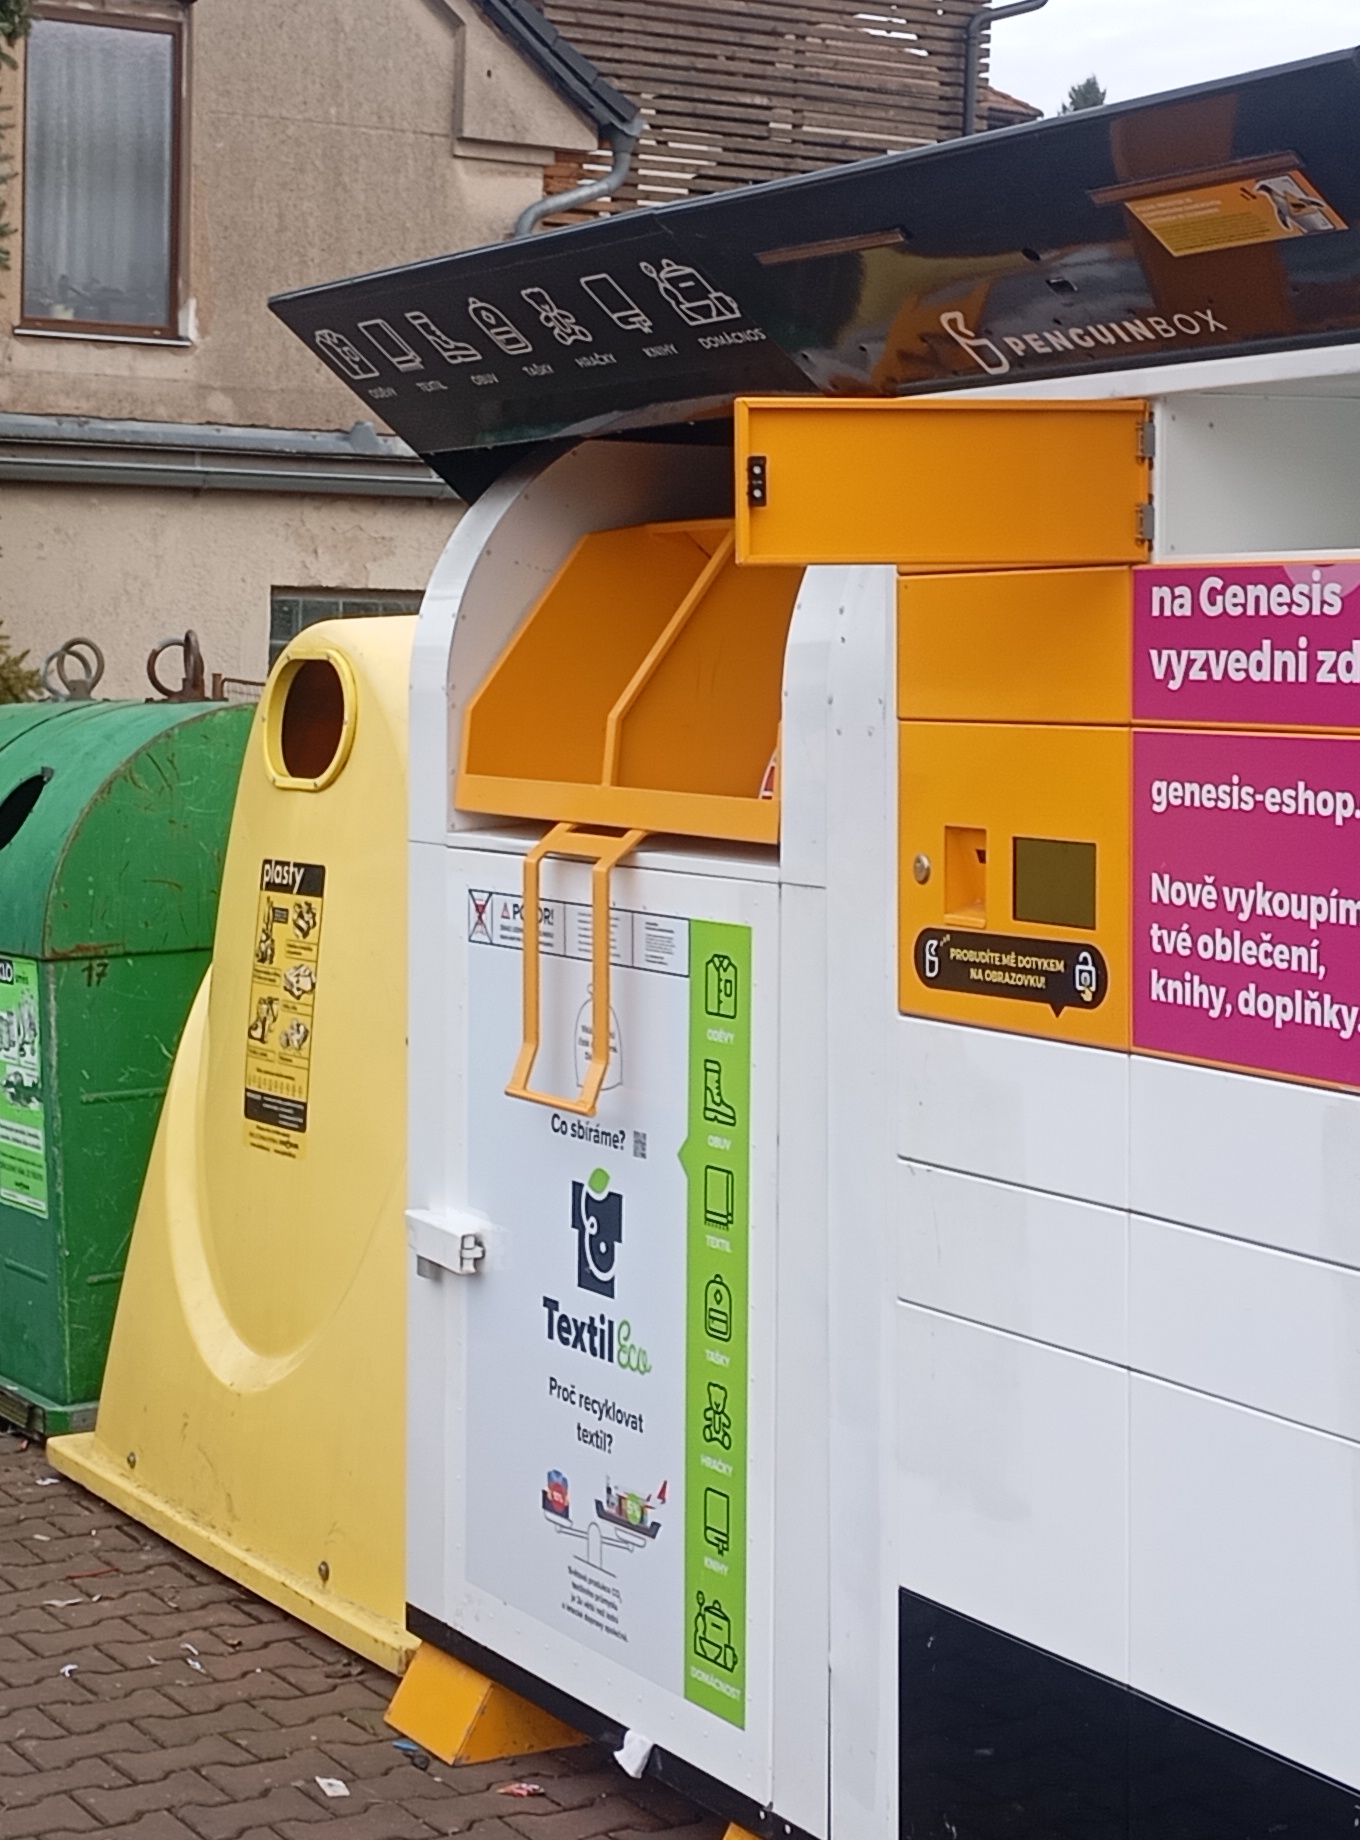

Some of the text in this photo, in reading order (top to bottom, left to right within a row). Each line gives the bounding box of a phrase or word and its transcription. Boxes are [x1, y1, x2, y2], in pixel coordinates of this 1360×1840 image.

[1002, 309, 1228, 357] PENGUINBOX
[1151, 570, 1343, 617] na Genesis
[1149, 636, 1309, 691] vyzvedni
[263, 859, 305, 895] plasty
[1150, 872, 1219, 911] Nově
[949, 947, 1001, 965] PROBUDÍTE
[1018, 955, 1065, 973] DOTYKEM
[1150, 922, 1327, 980] tvé oblečení,
[81, 961, 109, 988] 17
[970, 968, 1046, 989] NA OBRAZOVKU!
[1150, 968, 1233, 1019] knihy,
[551, 1113, 626, 1150] Co sbíráme?
[549, 1376, 644, 1433] Proč recyklovat
[577, 1422, 613, 1454] textil?
